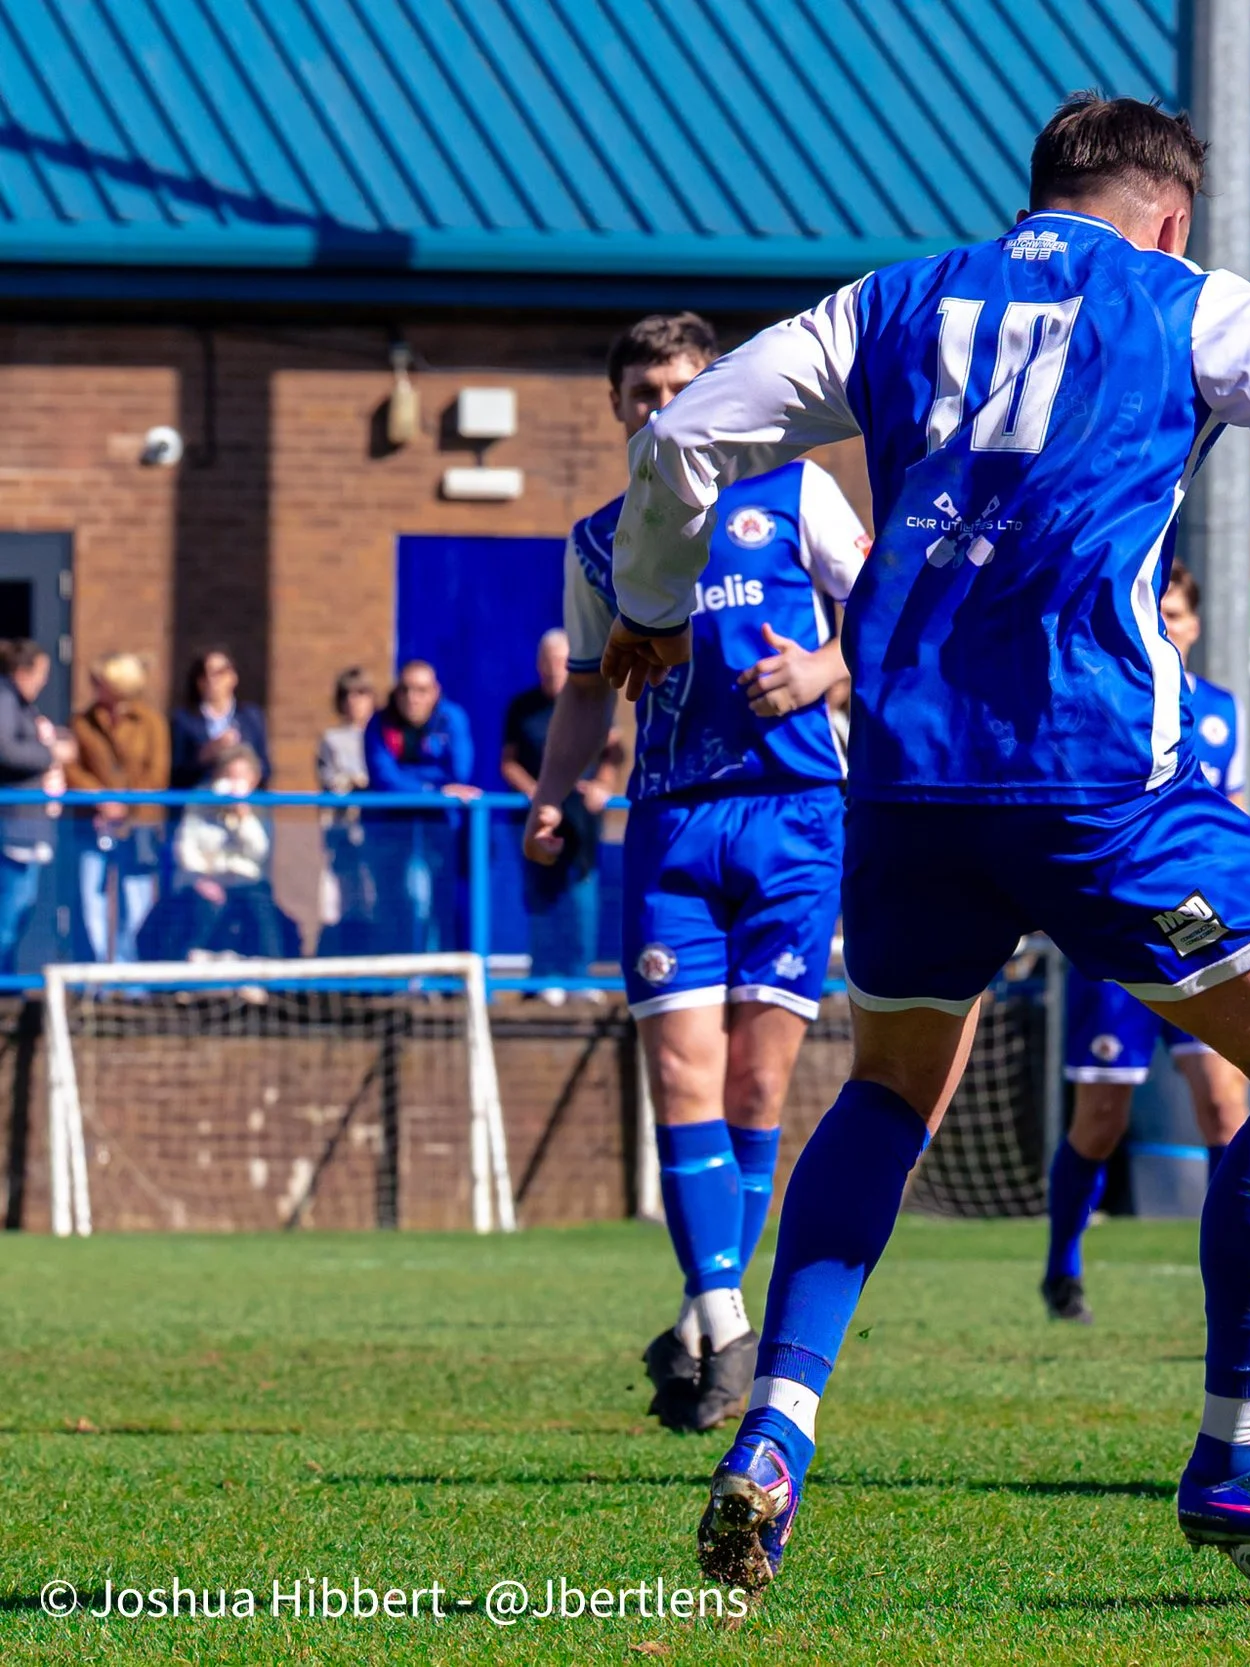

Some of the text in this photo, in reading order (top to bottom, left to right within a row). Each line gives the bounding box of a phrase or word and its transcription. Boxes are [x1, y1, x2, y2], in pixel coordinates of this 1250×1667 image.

[926, 295, 1083, 454] 10
[906, 516, 937, 529] CKR
[997, 520, 1023, 531] LTD
